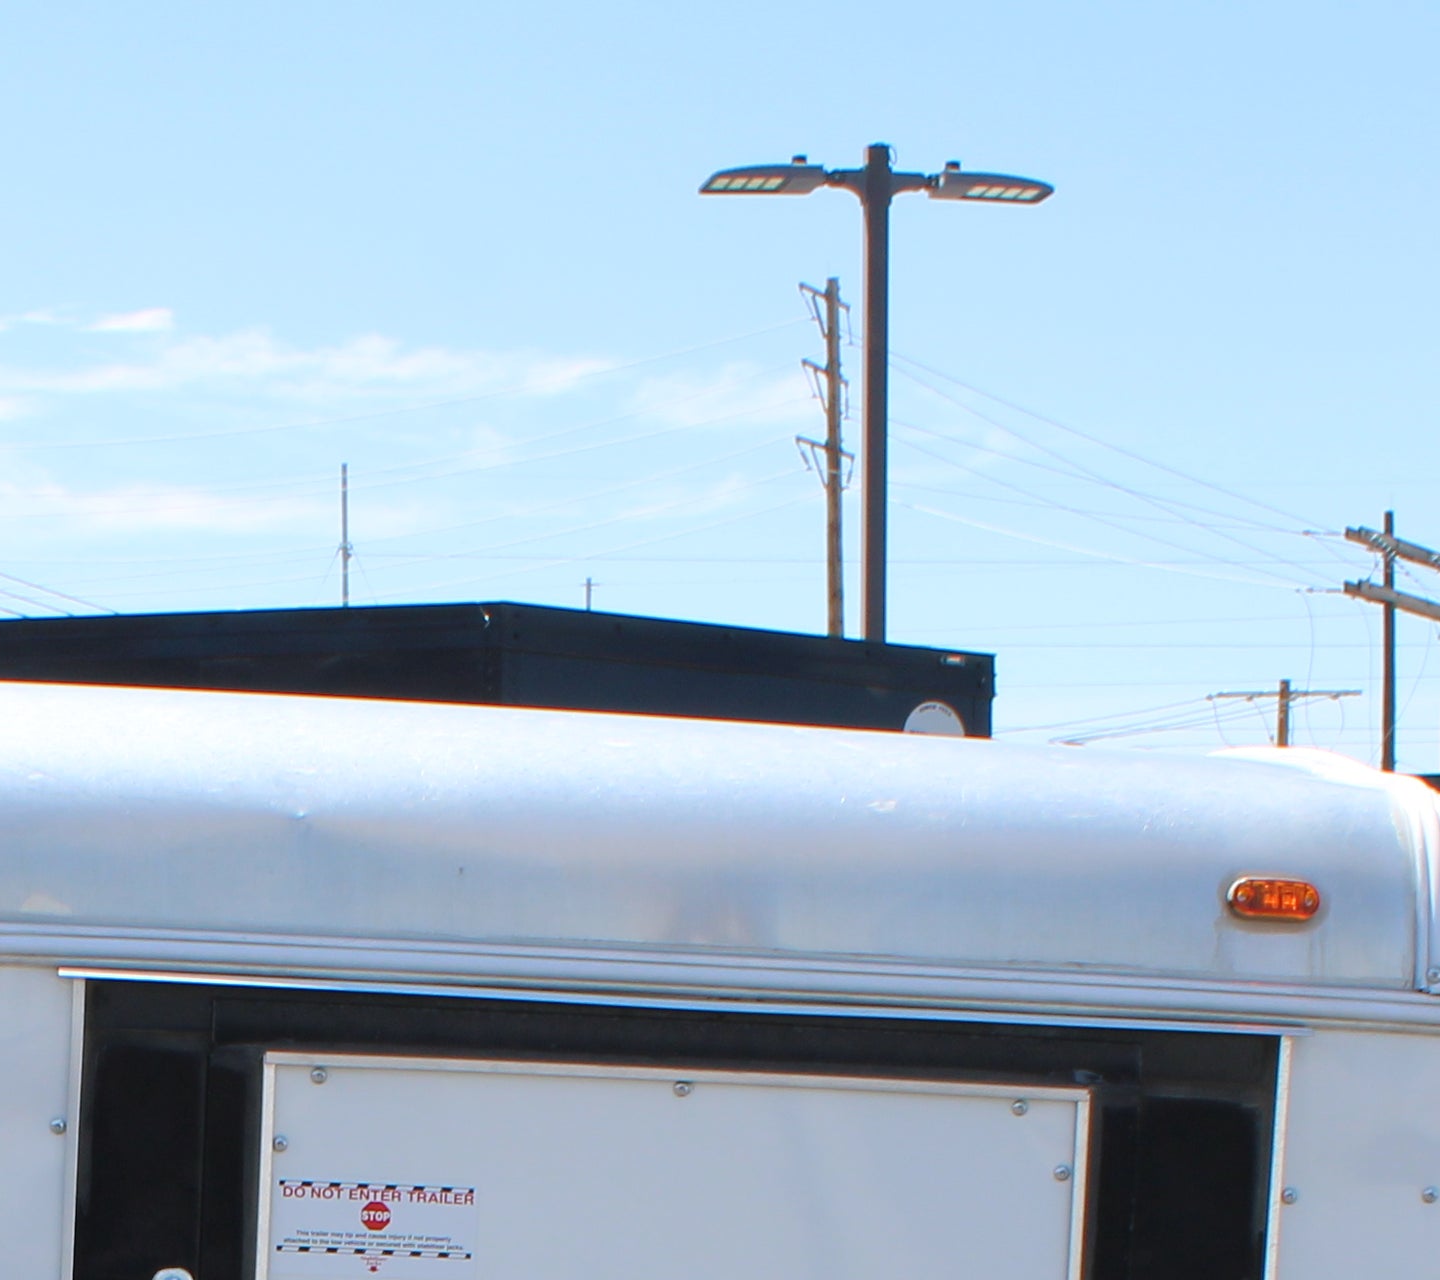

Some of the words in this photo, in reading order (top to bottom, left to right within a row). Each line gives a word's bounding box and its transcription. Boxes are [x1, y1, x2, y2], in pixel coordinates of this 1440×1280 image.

[283, 1186, 305, 1198] DO
[311, 1188, 343, 1200] NOT
[349, 1189, 401, 1201] ENTER
[407, 1191, 474, 1205] TRAILER
[361, 1211, 391, 1221] STOP
